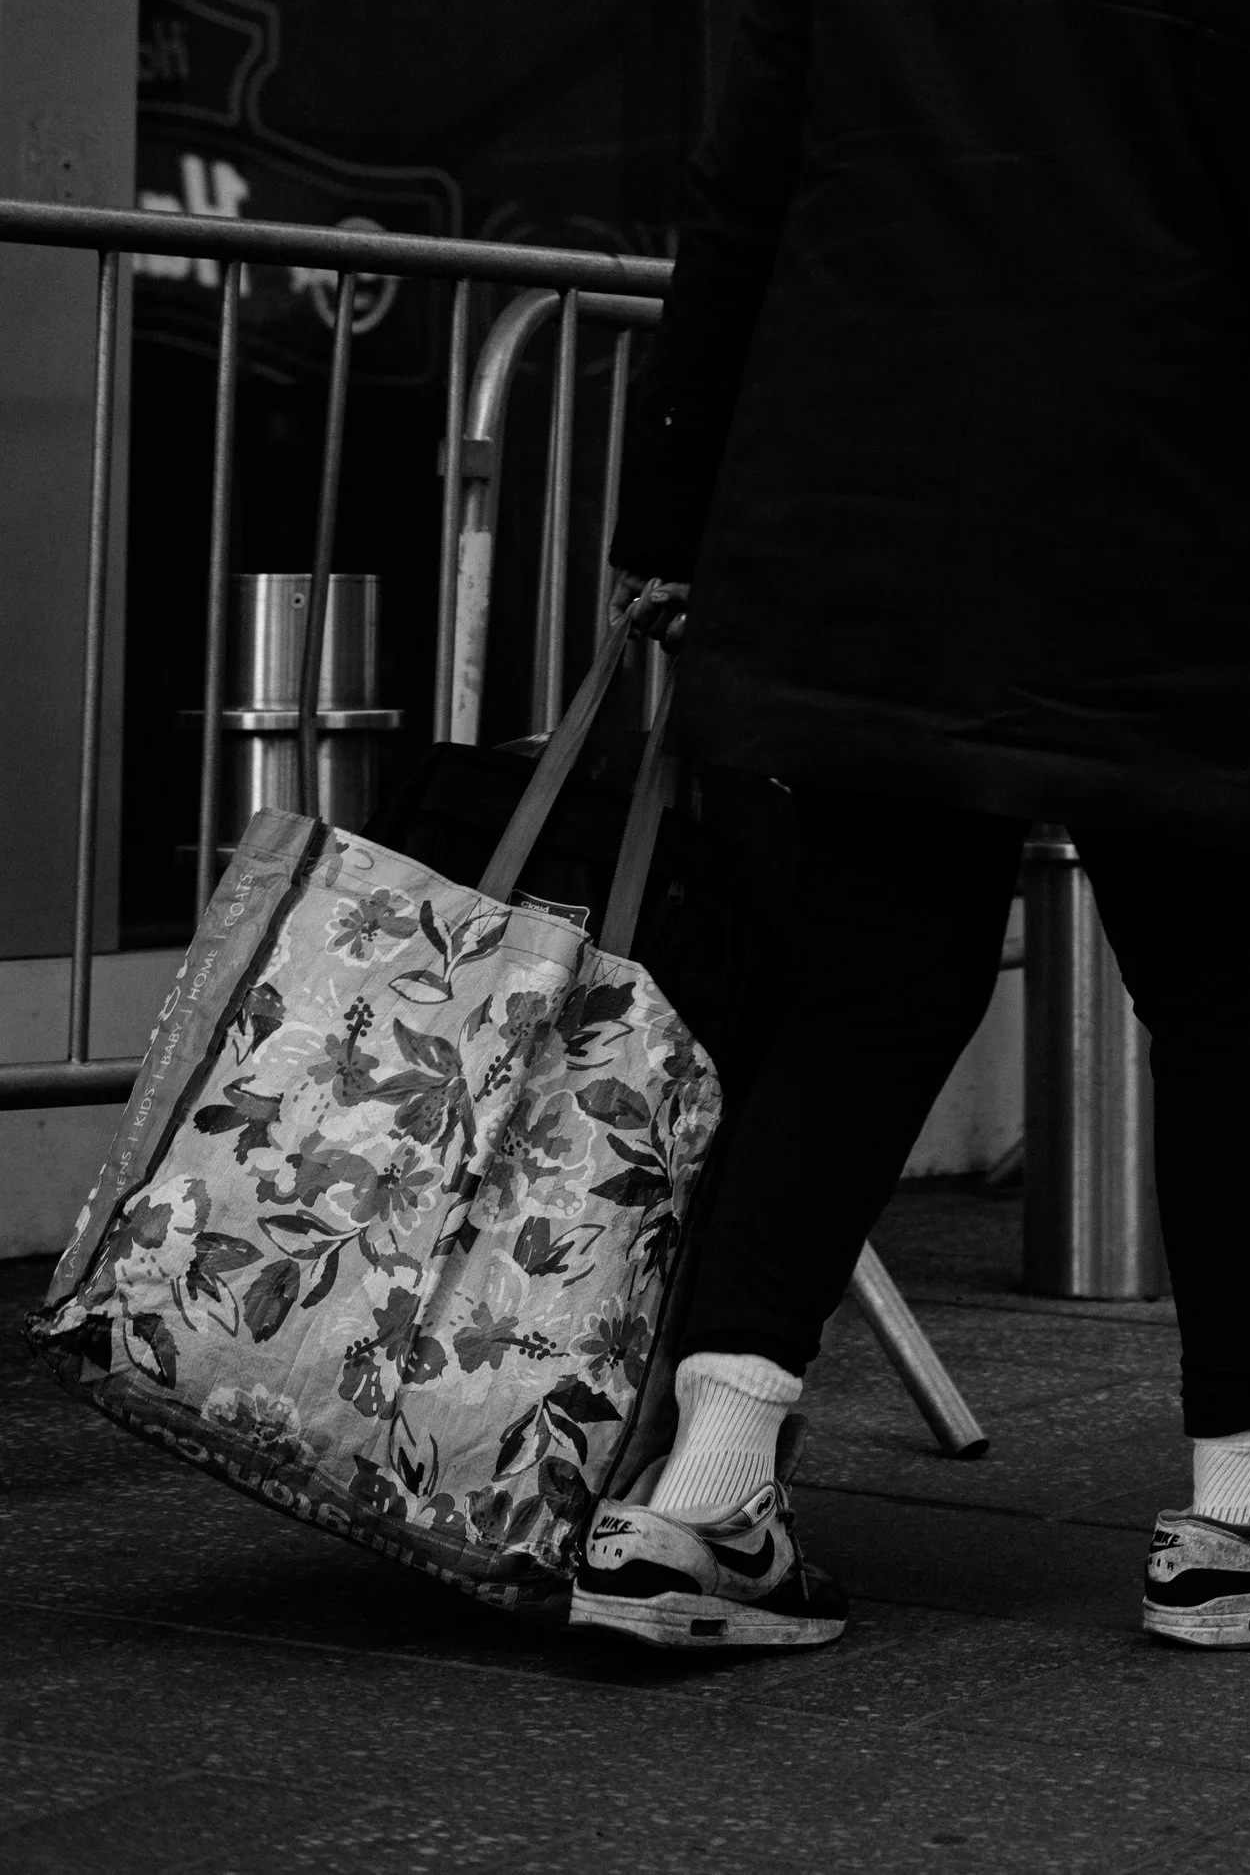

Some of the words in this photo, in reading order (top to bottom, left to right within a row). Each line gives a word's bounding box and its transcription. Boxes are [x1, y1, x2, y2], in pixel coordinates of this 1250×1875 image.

[133, 1086, 156, 1128] KIDS
[159, 1022, 183, 1066] BABY
[187, 948, 219, 1002] HOME
[224, 872, 254, 927] COATS
[600, 1515, 632, 1532] NIKE
[591, 1543, 624, 1558] AIR
